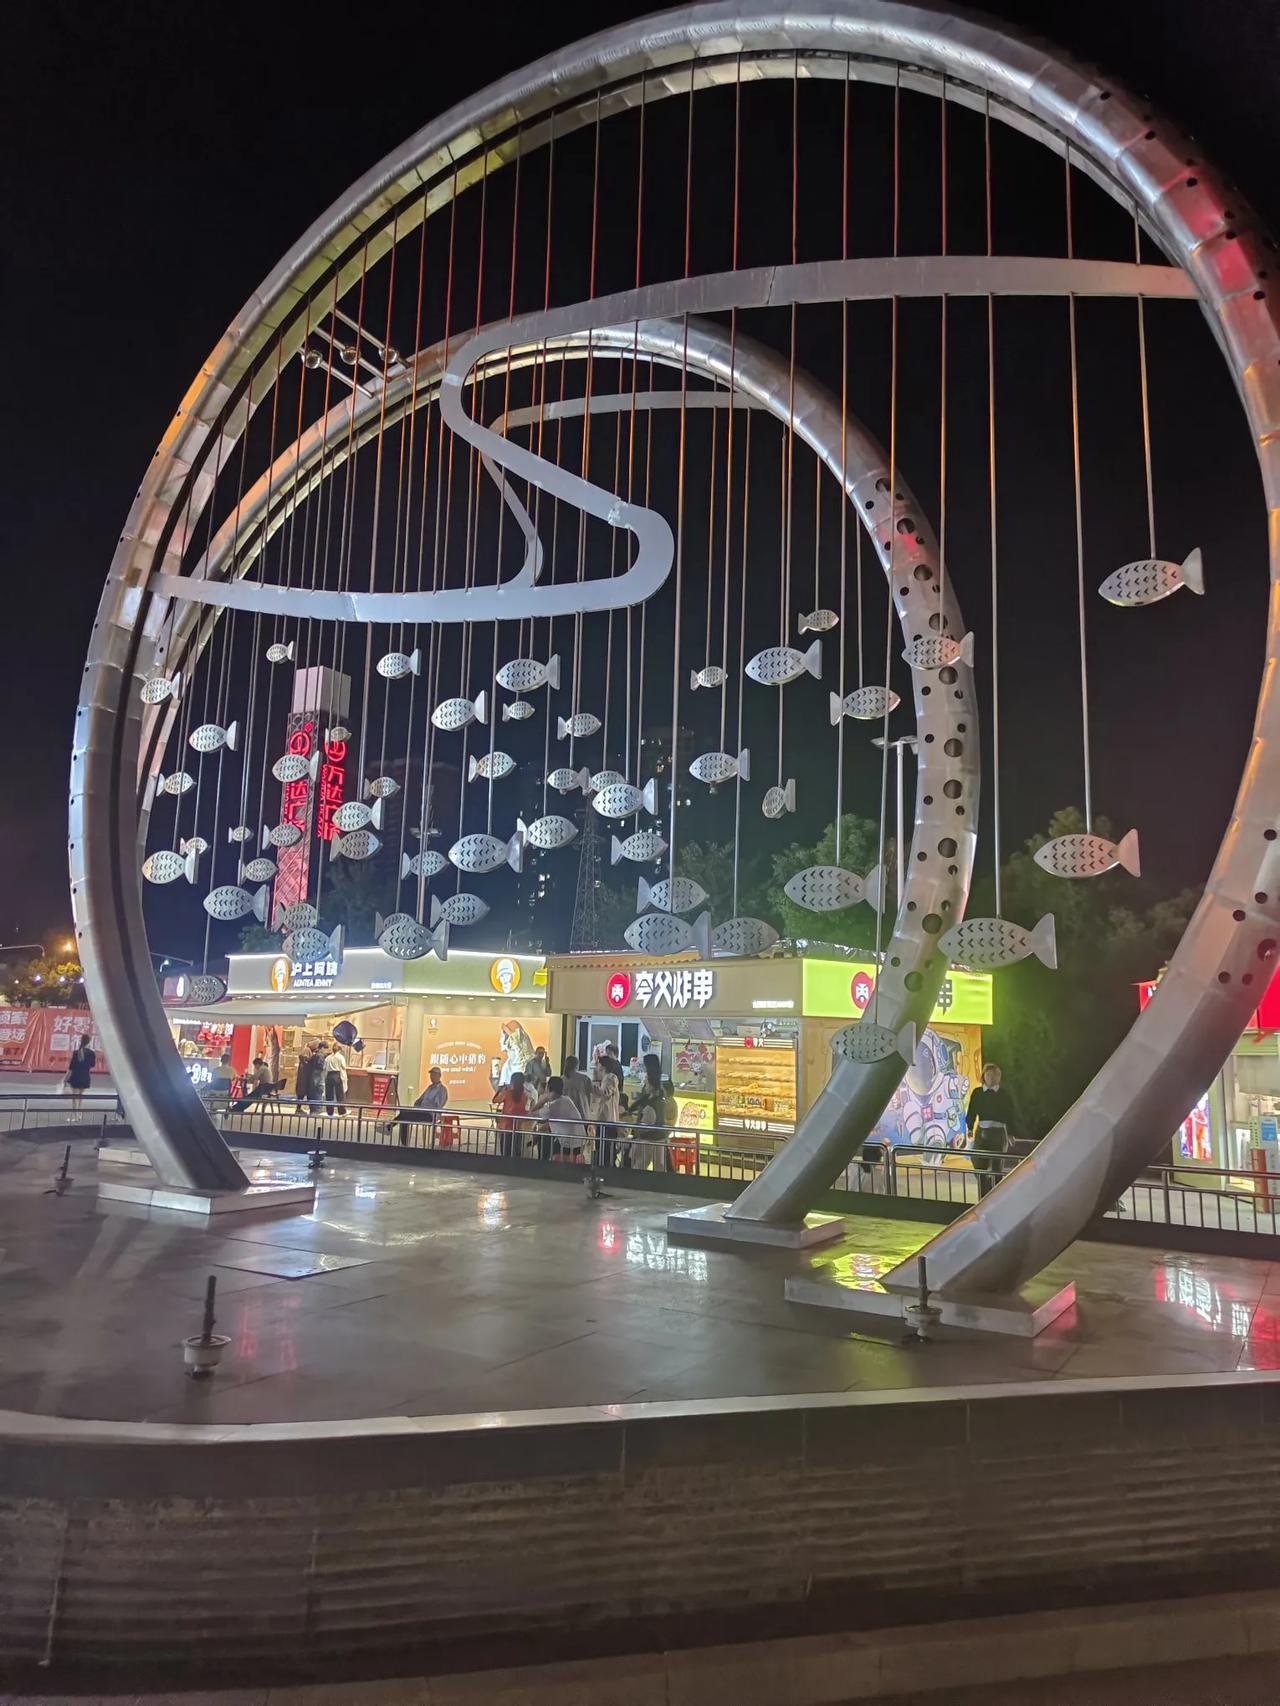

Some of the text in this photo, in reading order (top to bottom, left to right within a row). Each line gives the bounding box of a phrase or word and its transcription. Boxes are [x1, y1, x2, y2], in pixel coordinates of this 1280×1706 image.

[291, 961, 338, 977] 沪上阿姨
[635, 968, 714, 1009] 夸父炸串
